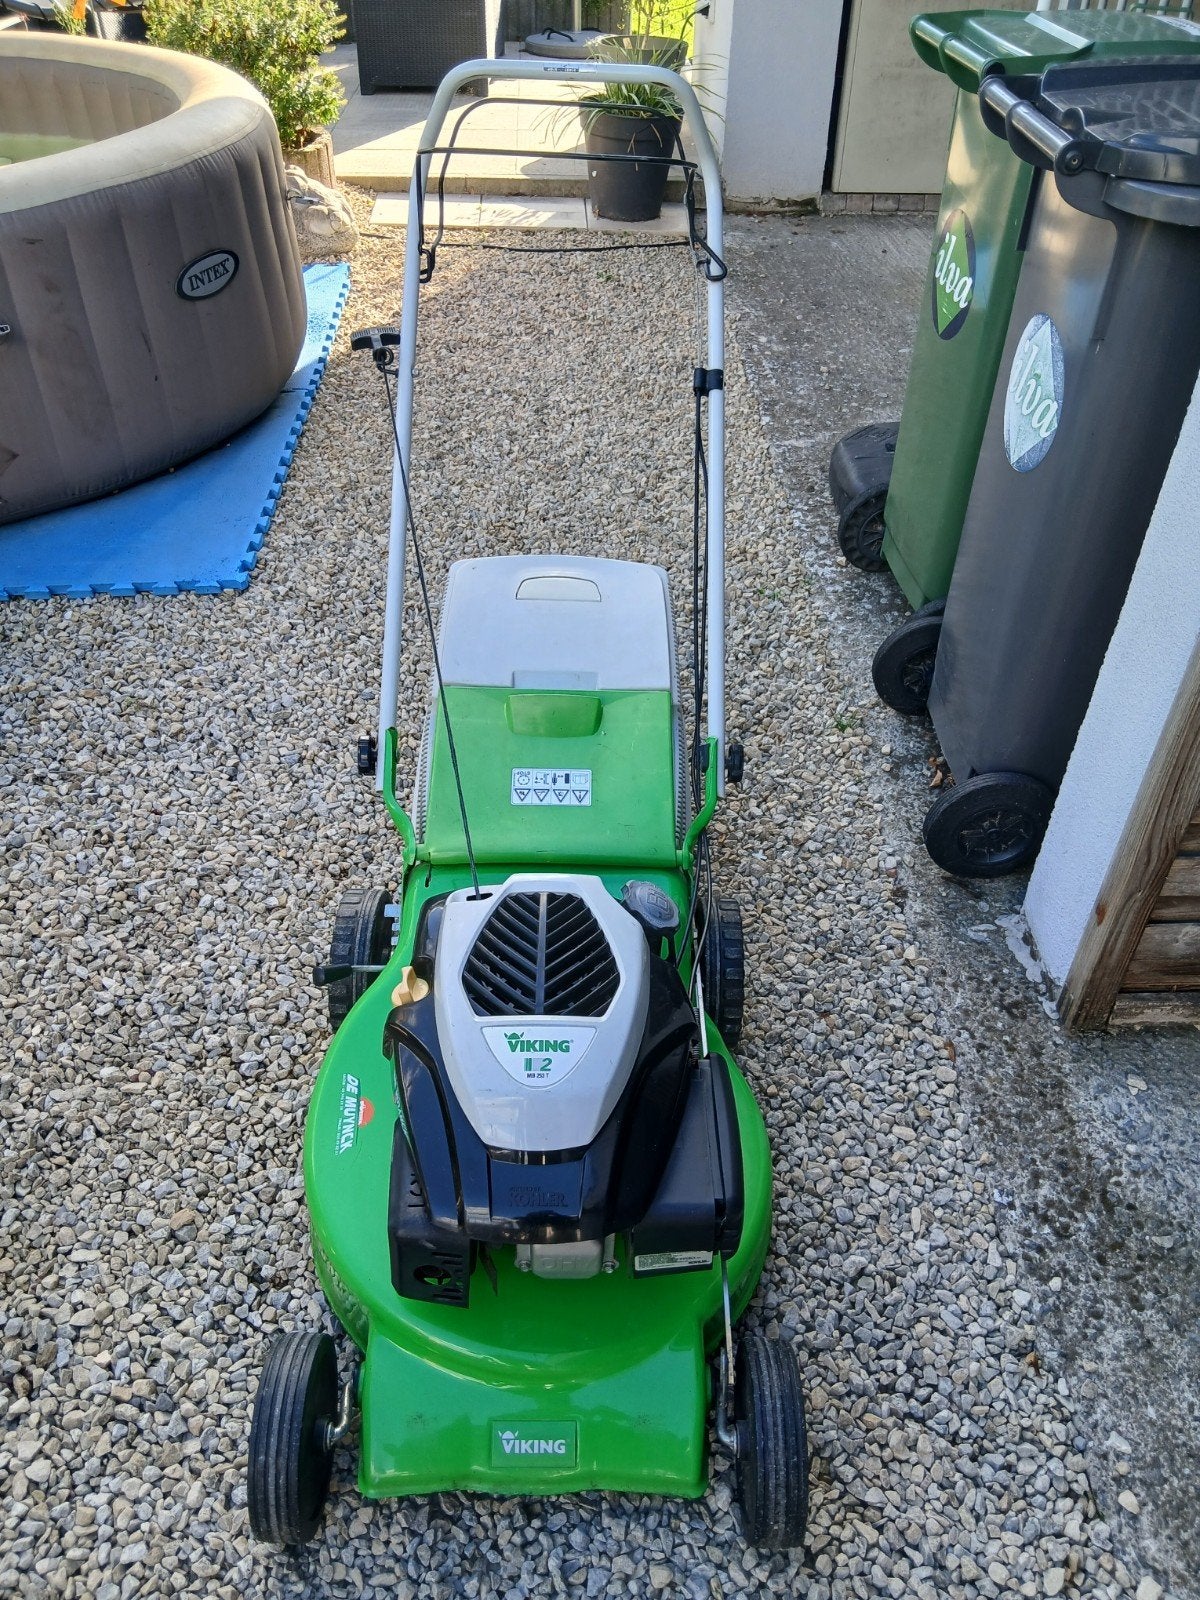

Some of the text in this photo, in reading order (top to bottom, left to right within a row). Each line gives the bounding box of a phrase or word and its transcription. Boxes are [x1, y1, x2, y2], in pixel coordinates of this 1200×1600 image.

[187, 257, 230, 292] INTEX
[935, 231, 973, 309] ilva
[1008, 338, 1058, 438] ilva
[507, 1040, 570, 1052] VIKING
[346, 1073, 359, 1095] DE
[339, 1095, 358, 1155] MUYNCK
[501, 1439, 567, 1454] VIKING
